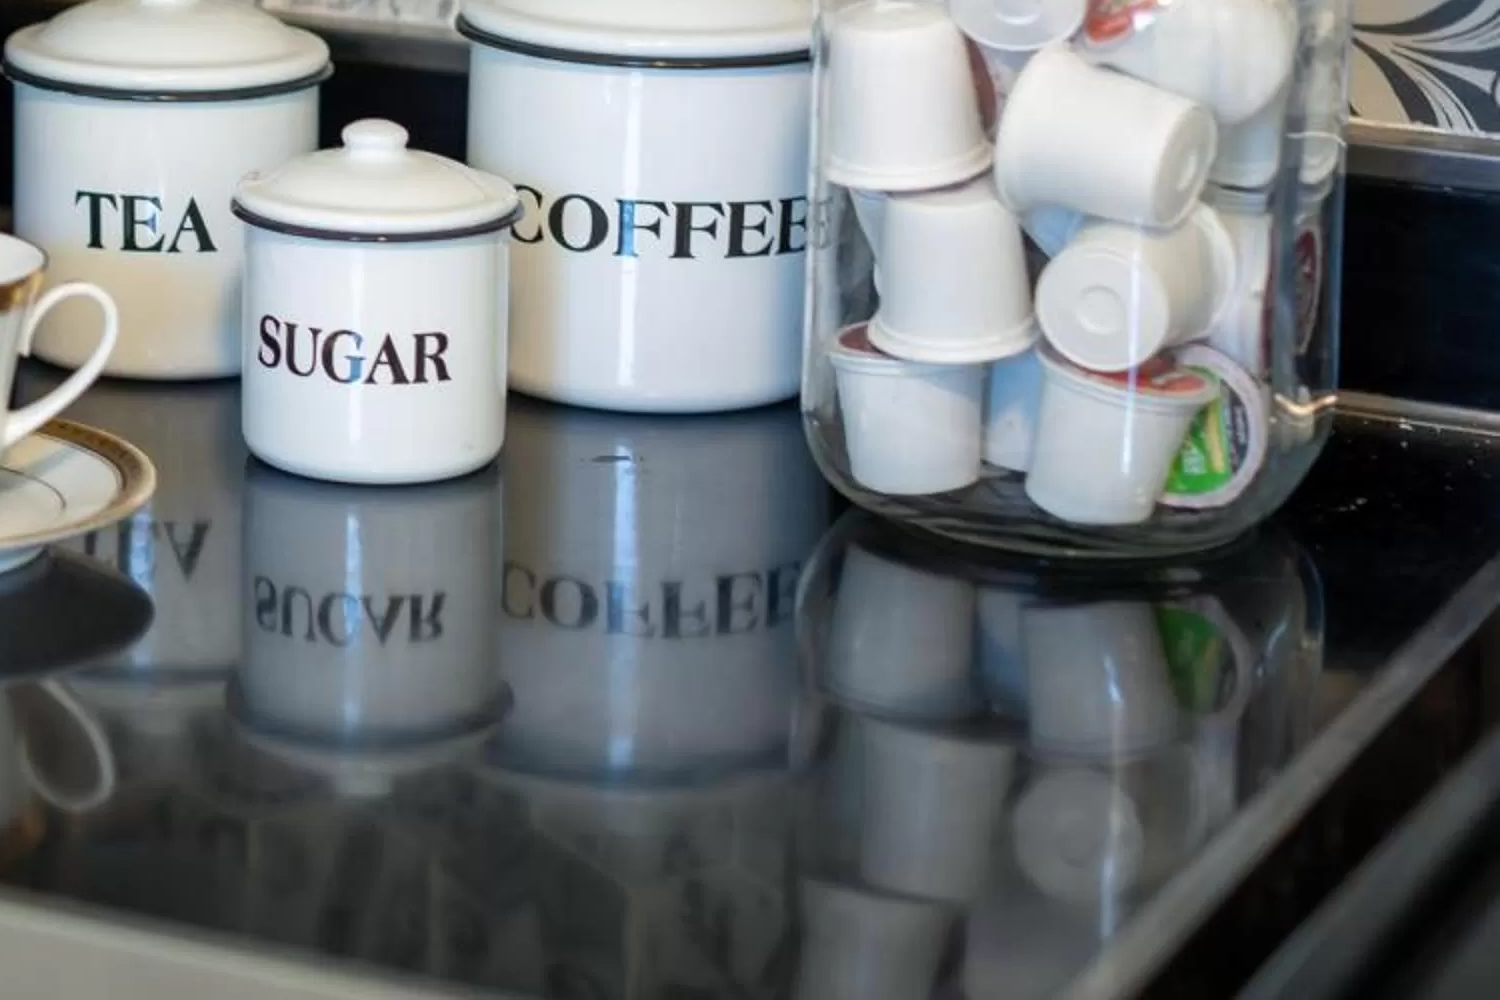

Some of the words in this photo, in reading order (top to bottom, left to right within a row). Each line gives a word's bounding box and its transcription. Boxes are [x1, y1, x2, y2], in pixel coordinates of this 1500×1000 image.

[75, 189, 217, 253] TEA
[509, 184, 808, 259] COFFEE
[257, 314, 452, 385] SUGAR
